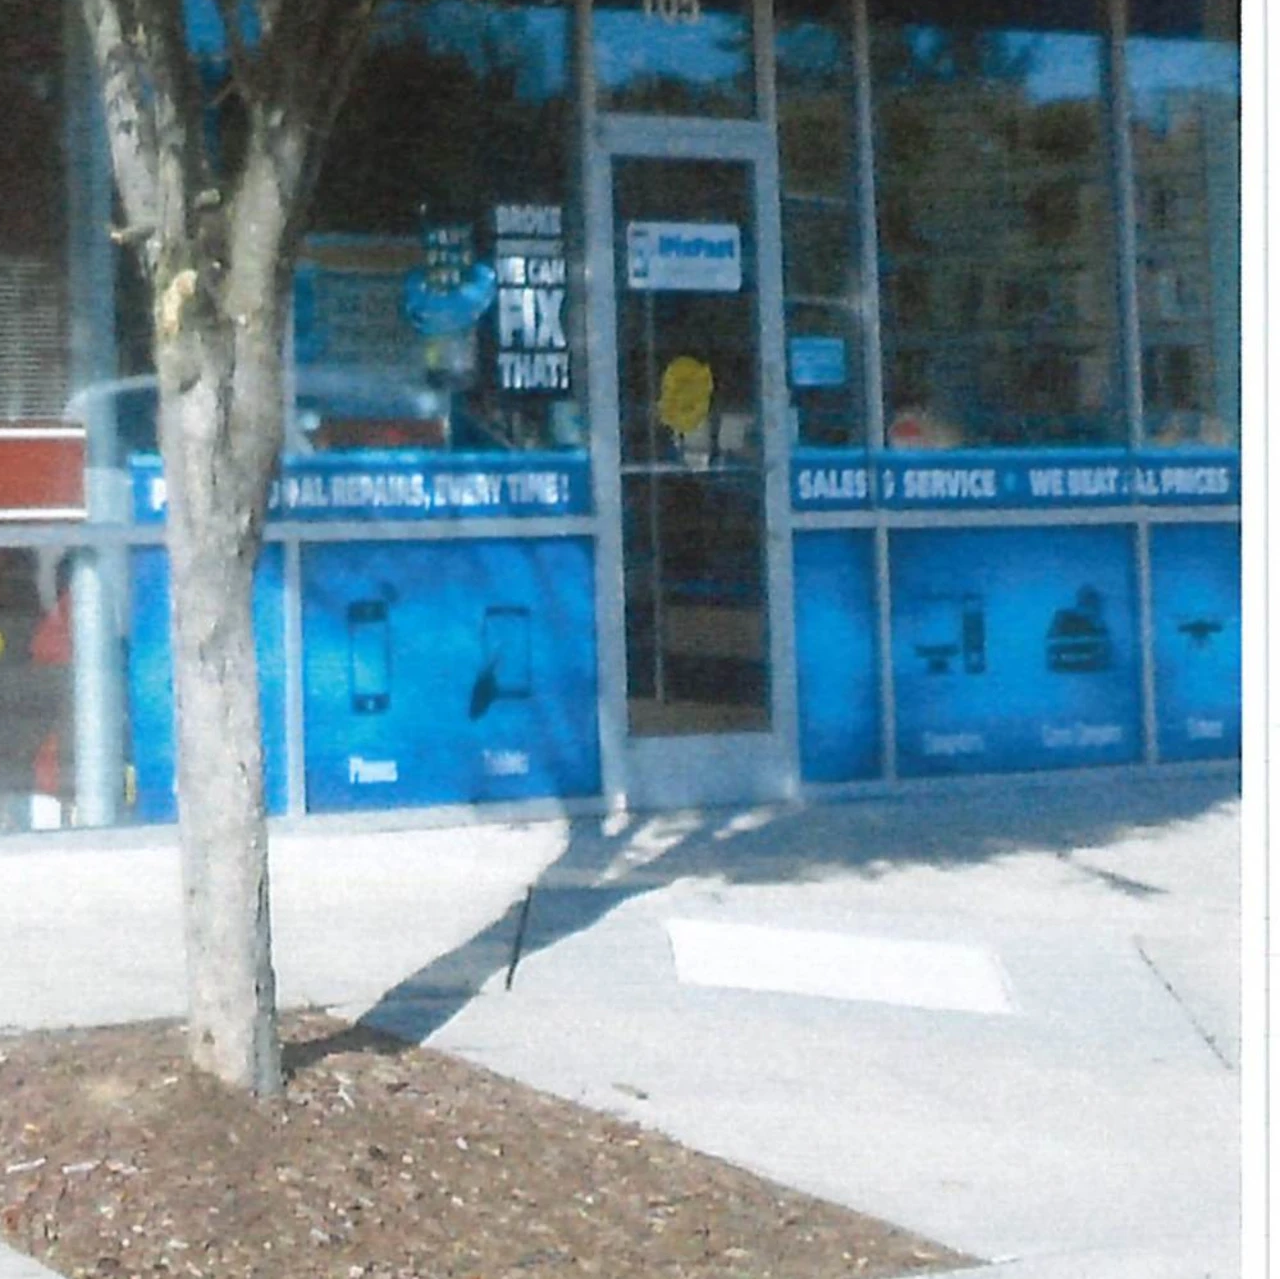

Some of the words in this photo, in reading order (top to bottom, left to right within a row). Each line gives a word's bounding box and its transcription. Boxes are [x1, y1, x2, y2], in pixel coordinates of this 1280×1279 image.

[528, 258, 566, 285] CAN
[498, 288, 566, 347] FIX
[498, 352, 569, 389] THAT!
[798, 468, 867, 500] SALES
[903, 468, 997, 499] SERVICE
[1029, 468, 1065, 496] WE
[1161, 466, 1230, 495] PRICES
